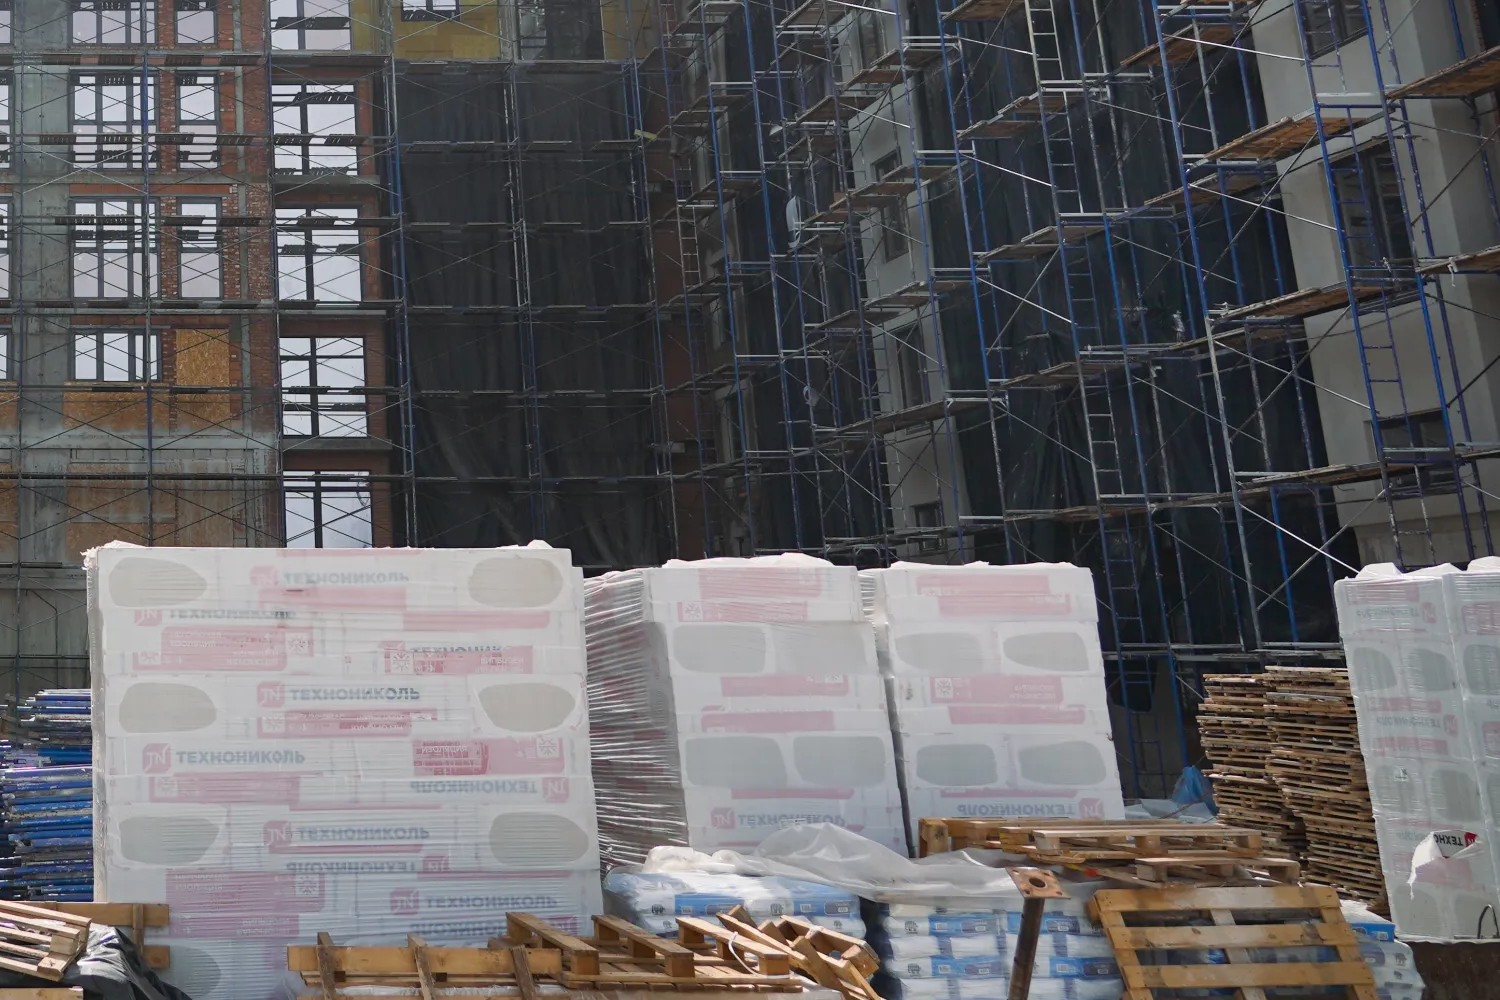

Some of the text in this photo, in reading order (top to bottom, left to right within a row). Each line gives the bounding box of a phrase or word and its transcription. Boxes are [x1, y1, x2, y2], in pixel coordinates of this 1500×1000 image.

[283, 571, 410, 585] ТЕХНОНИКОЛЬ
[289, 687, 421, 701] ТЕХНОНИКОЛЬ
[176, 750, 306, 765] ТЕХНОНИКОЛЬ
[410, 780, 538, 794] ТЕХНОНИКОЛЬ
[957, 803, 1077, 817] ТЕХНОНИКОЛЬ
[298, 827, 430, 841] ТЕХНОНИКОЛЬ
[425, 894, 558, 909] ТЕХНОНИКОЛЬ
